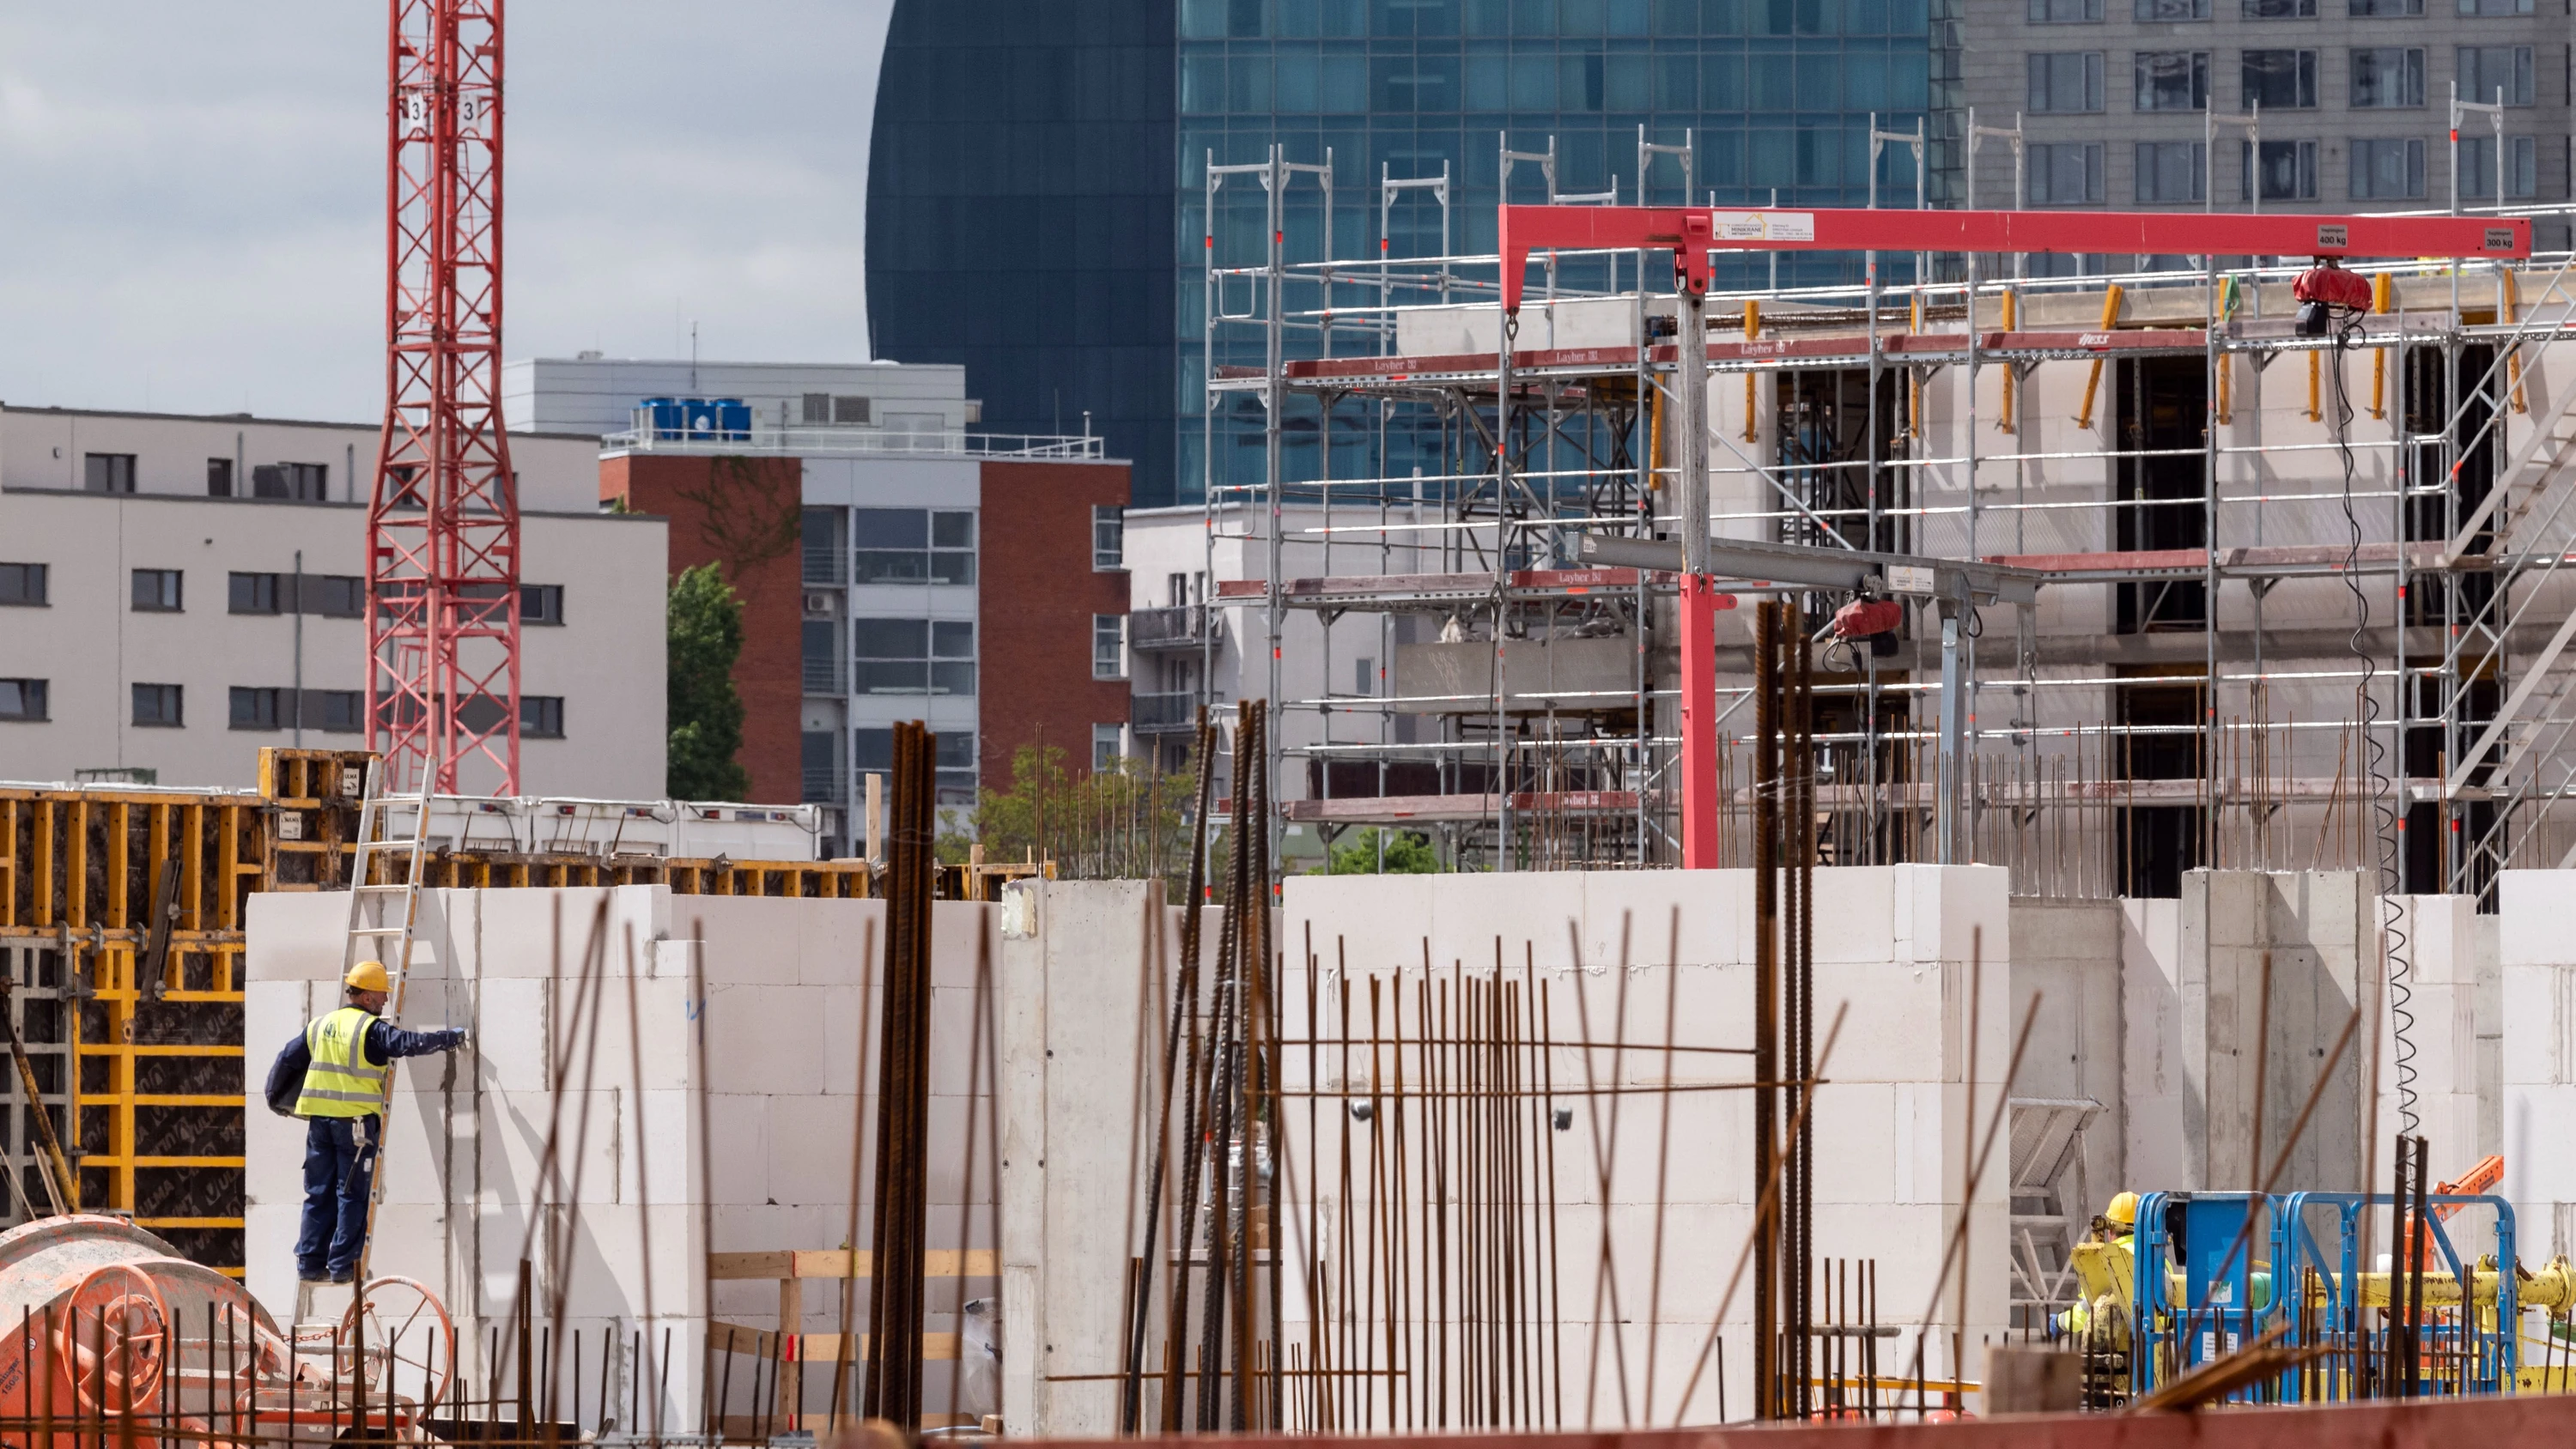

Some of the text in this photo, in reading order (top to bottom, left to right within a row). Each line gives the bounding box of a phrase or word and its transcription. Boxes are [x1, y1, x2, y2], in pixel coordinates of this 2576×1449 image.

[412, 102, 420, 120] 3
[464, 102, 473, 120] 3
[2336, 236, 2346, 246] kg
[2503, 239, 2512, 249] kg
[1741, 343, 1773, 356] Layher
[1556, 351, 1585, 364] Layher
[1375, 361, 1405, 373] Layher
[1558, 572, 1589, 584] Layher
[137, 1179, 175, 1216] ULMA
